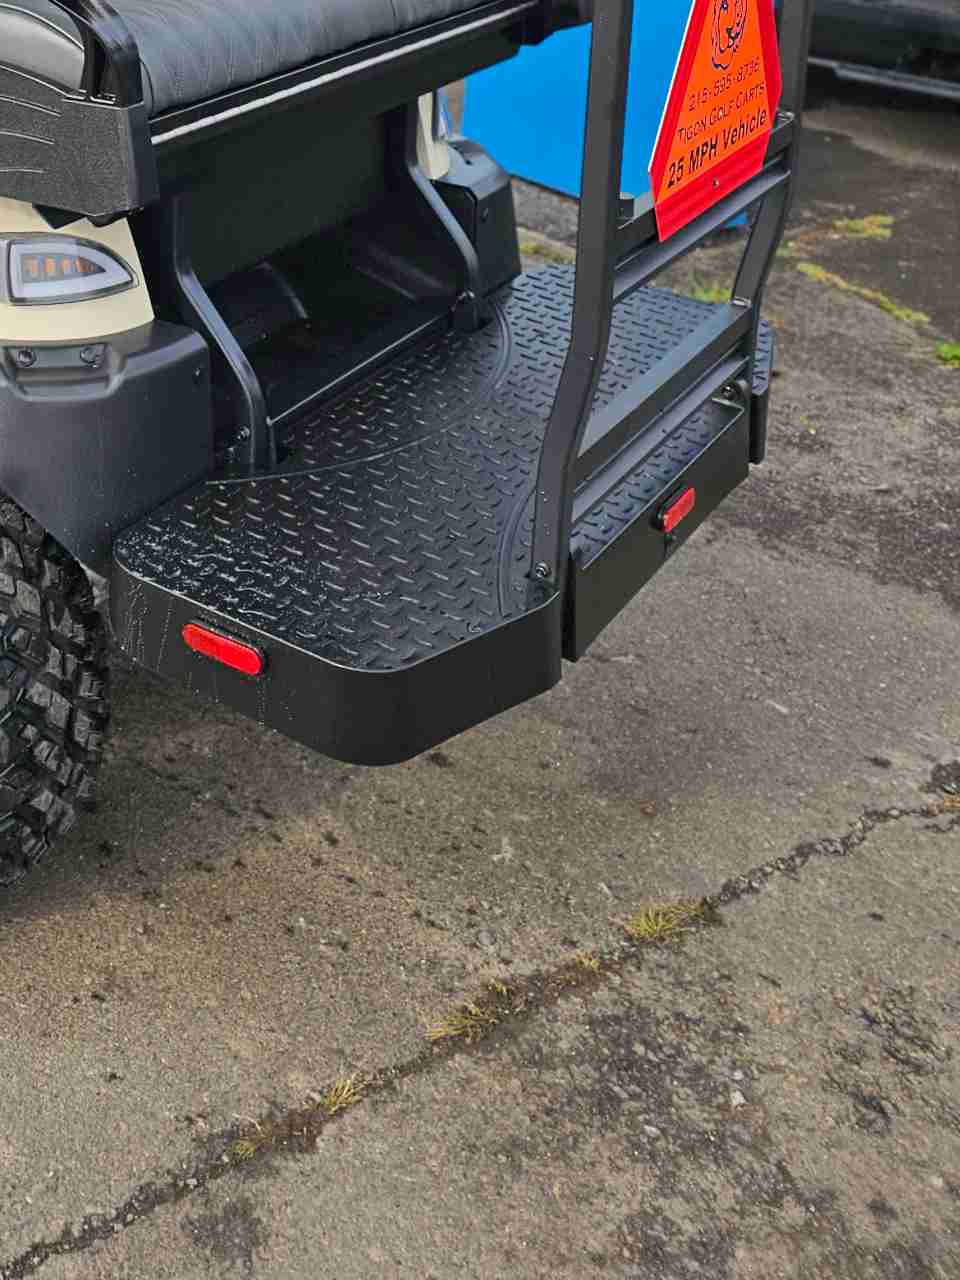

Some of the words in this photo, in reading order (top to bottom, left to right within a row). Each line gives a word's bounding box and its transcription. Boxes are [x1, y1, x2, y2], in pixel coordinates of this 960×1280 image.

[667, 156, 684, 189] 25
[688, 134, 719, 174] MPH
[722, 107, 768, 150] Vehicle
[678, 115, 707, 144] TIGON
[709, 99, 735, 127] GOLF
[736, 81, 766, 110] CARTS
